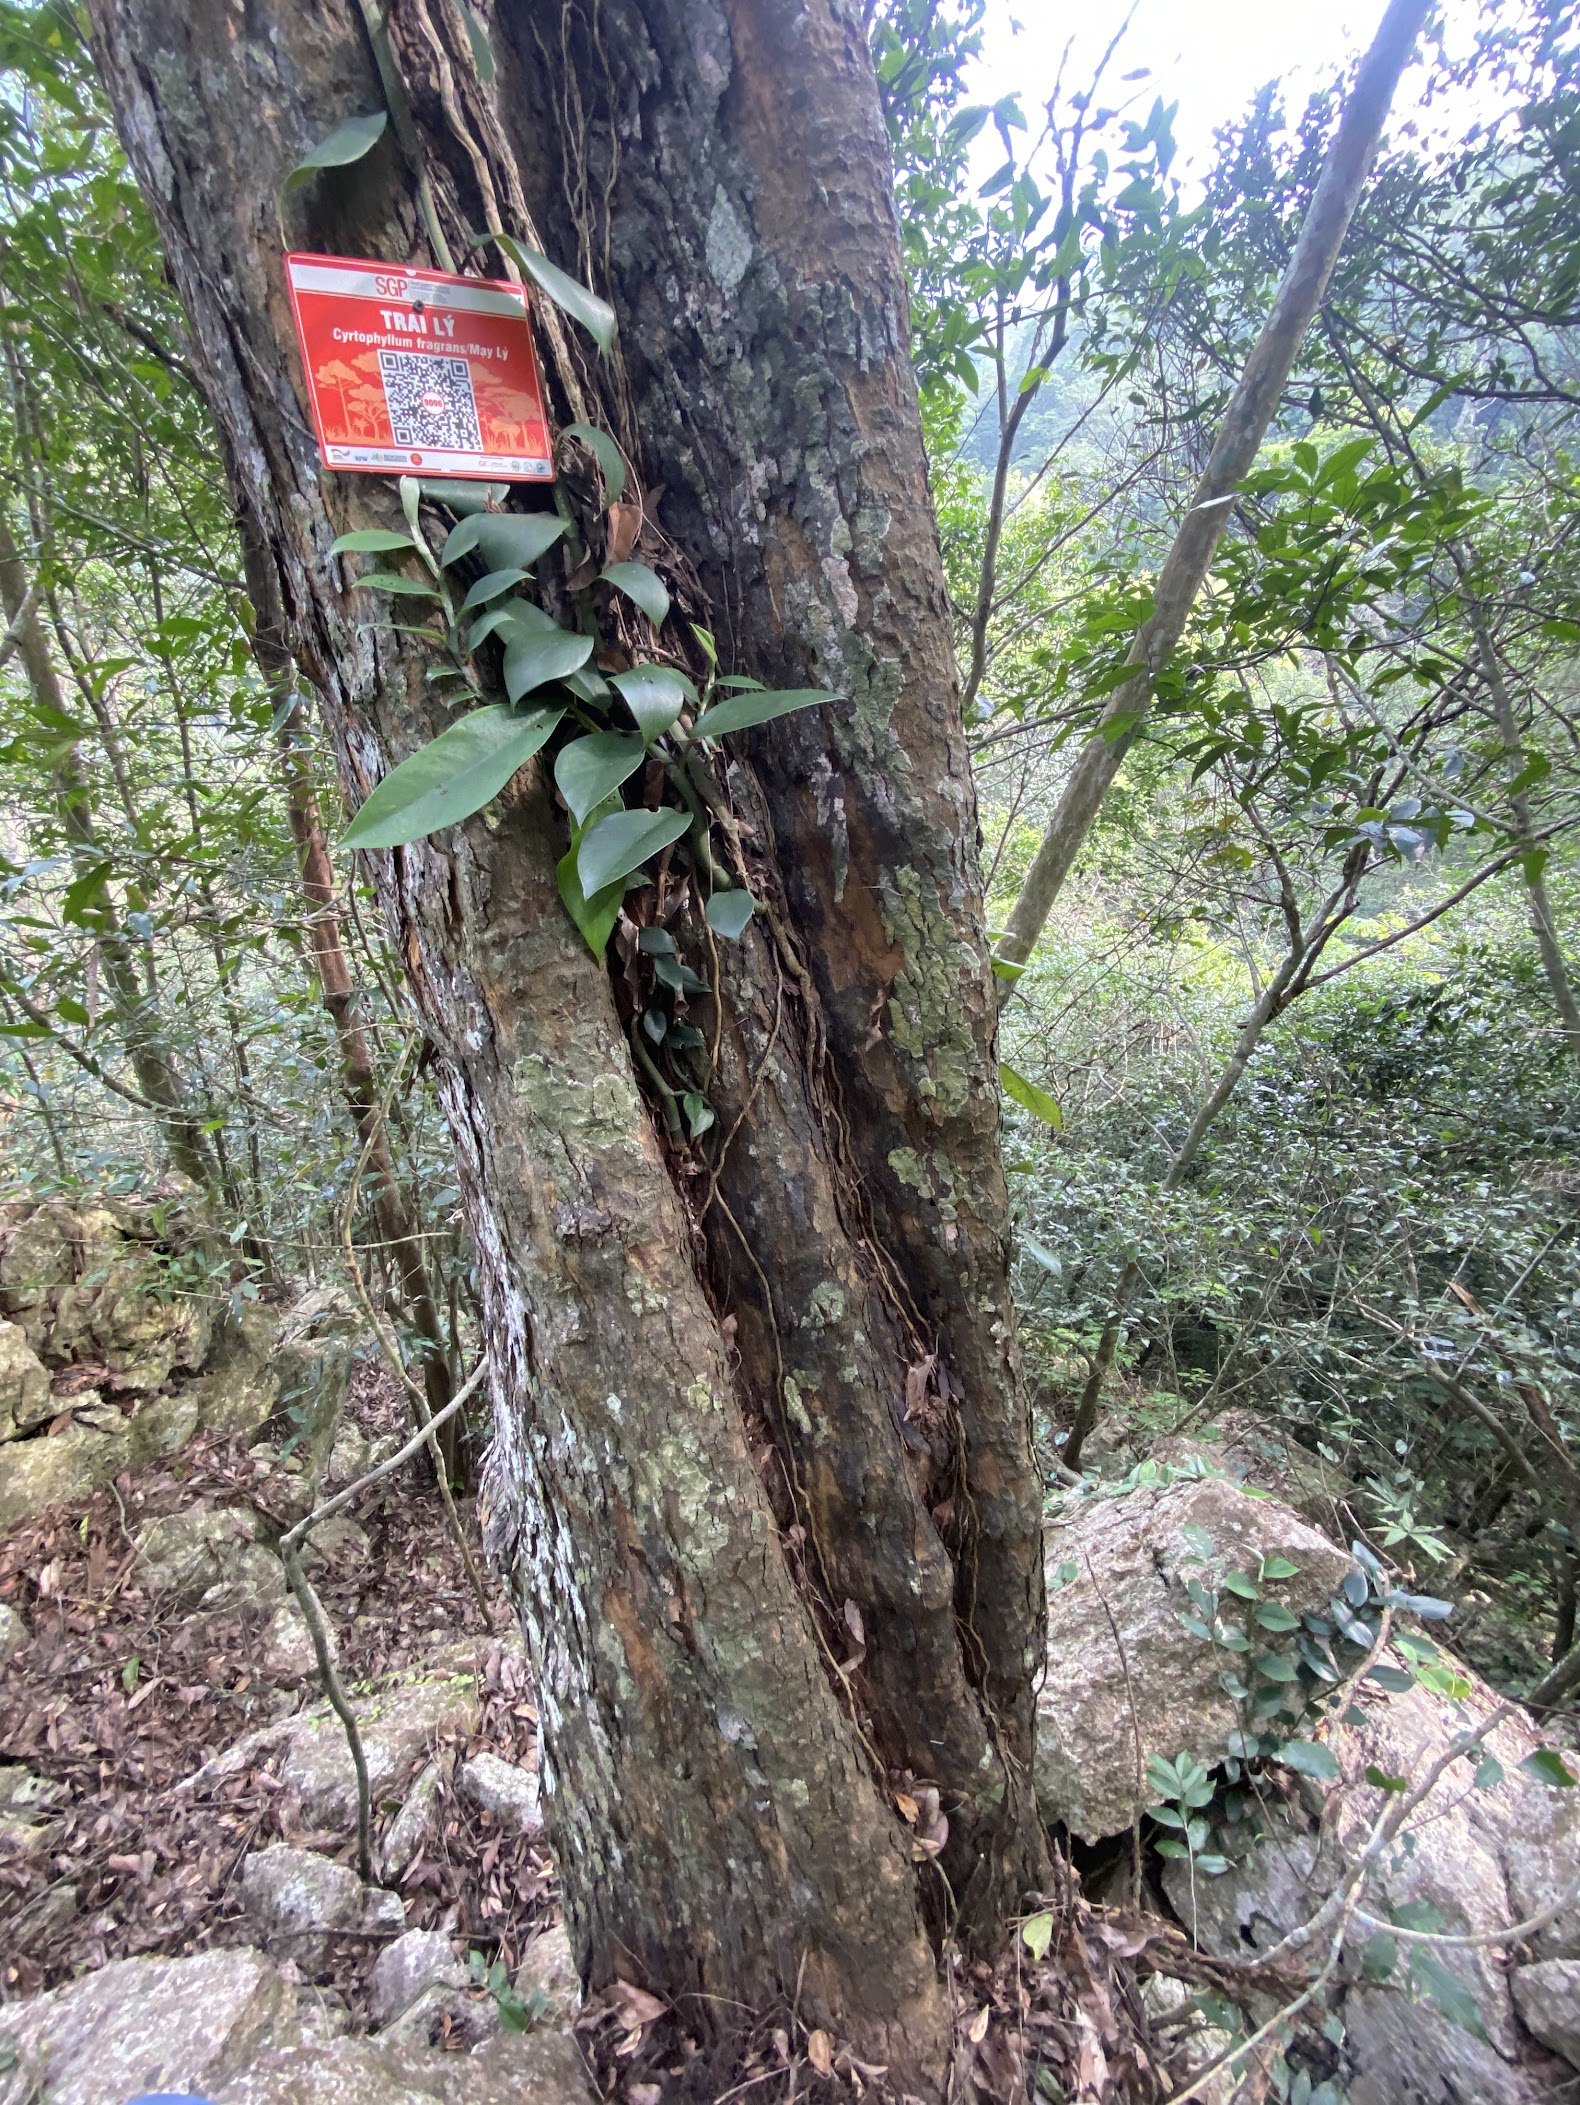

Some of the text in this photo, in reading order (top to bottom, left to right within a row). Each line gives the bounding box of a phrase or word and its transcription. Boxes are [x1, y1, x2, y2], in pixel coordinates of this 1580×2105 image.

[375, 276, 408, 297] SGP
[380, 310, 455, 337] TRAI LÝ
[332, 327, 413, 348] Cyrtophyllum
